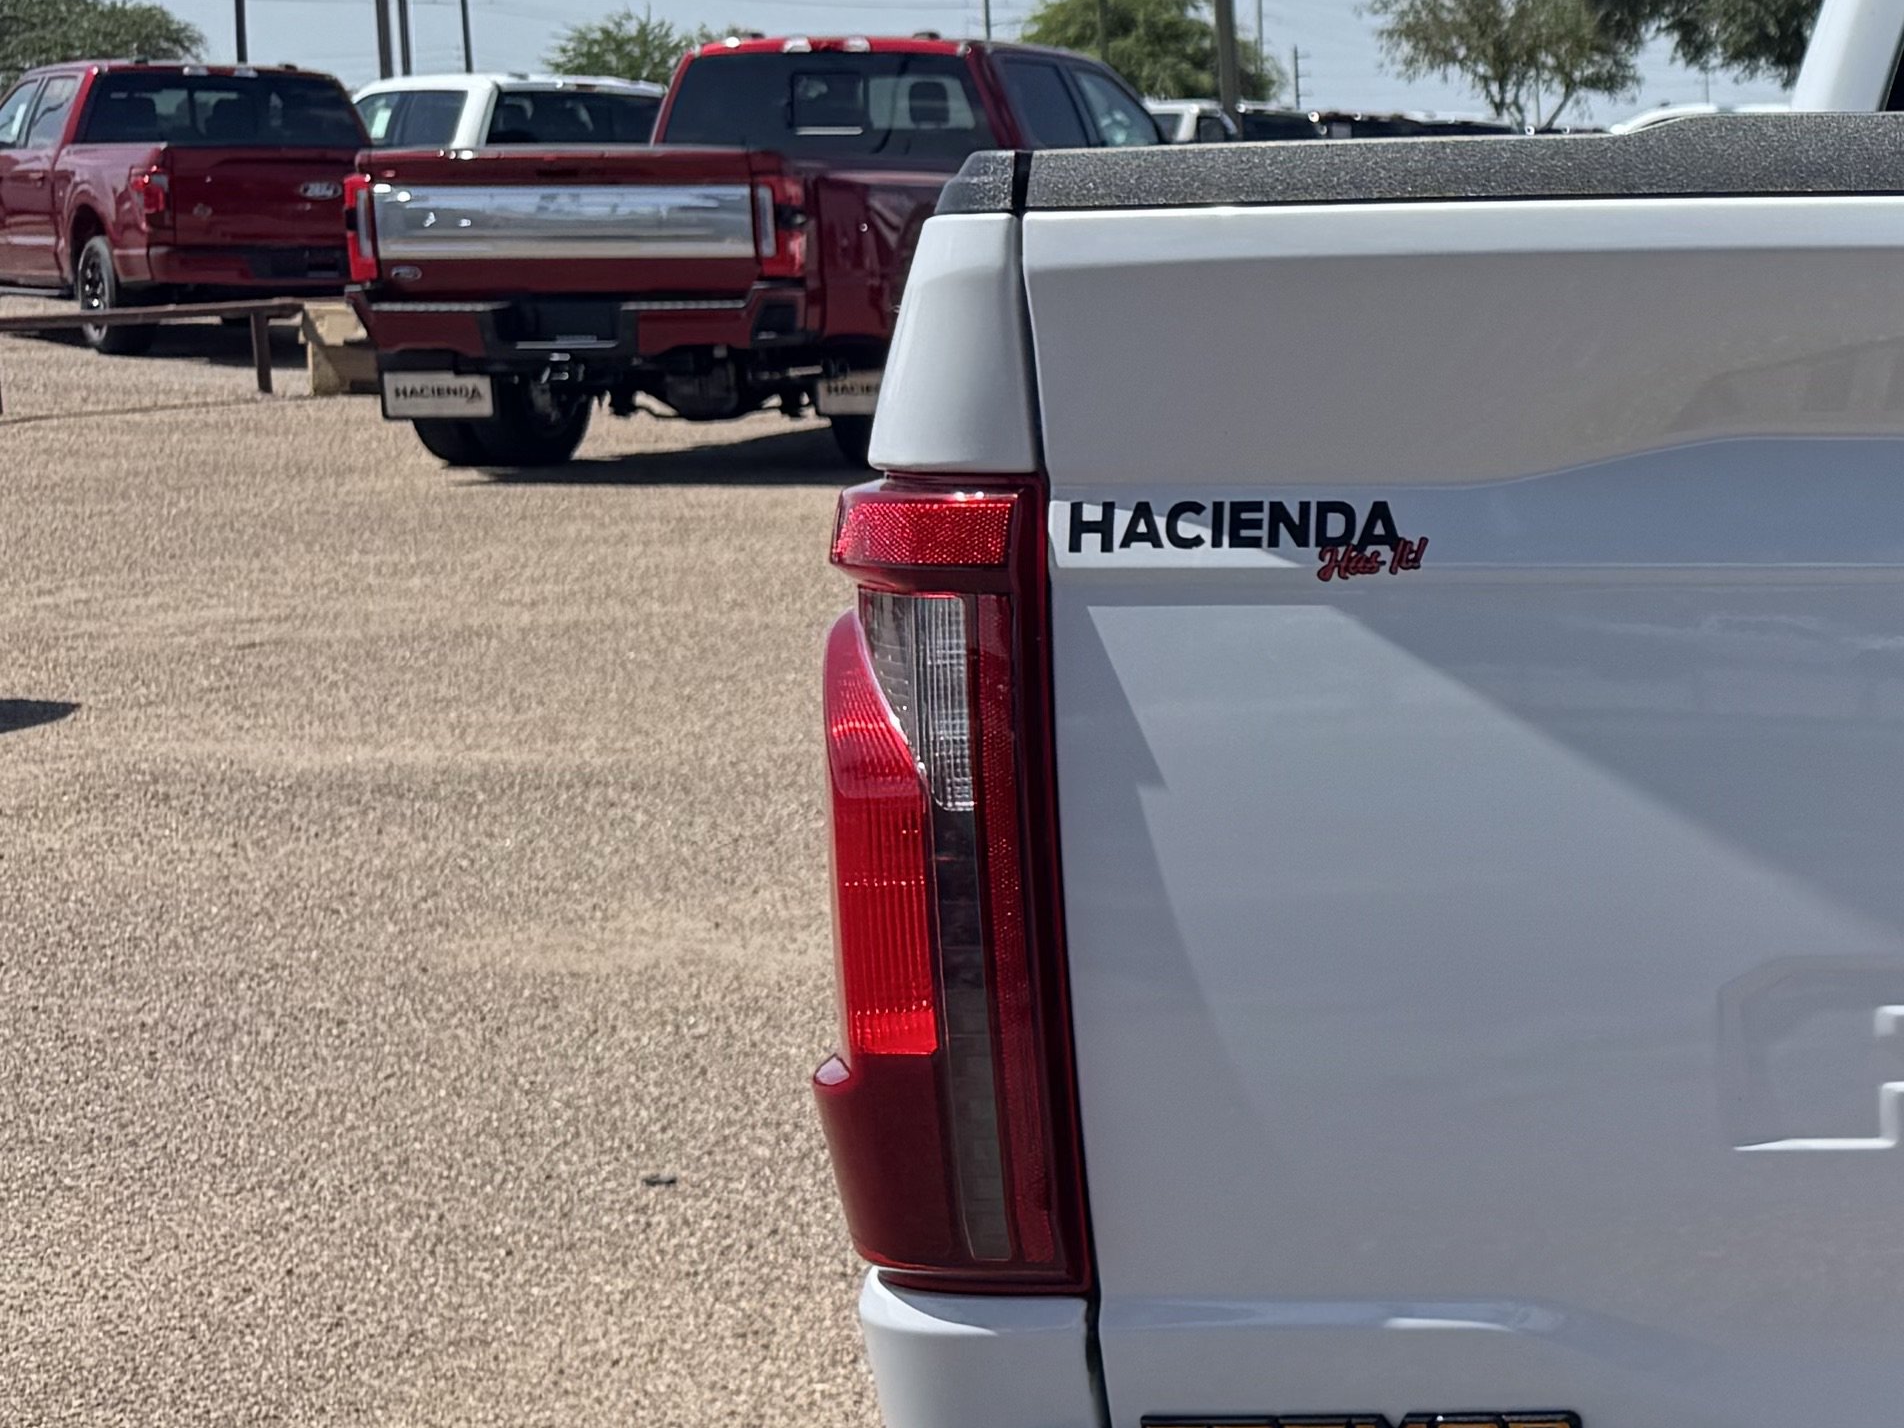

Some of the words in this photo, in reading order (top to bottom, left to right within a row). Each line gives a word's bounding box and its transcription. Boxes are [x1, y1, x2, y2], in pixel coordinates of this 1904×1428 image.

[1068, 500, 1401, 553] HACIENDA
[1317, 542, 1386, 582] Has
[1389, 536, 1429, 575] It!
